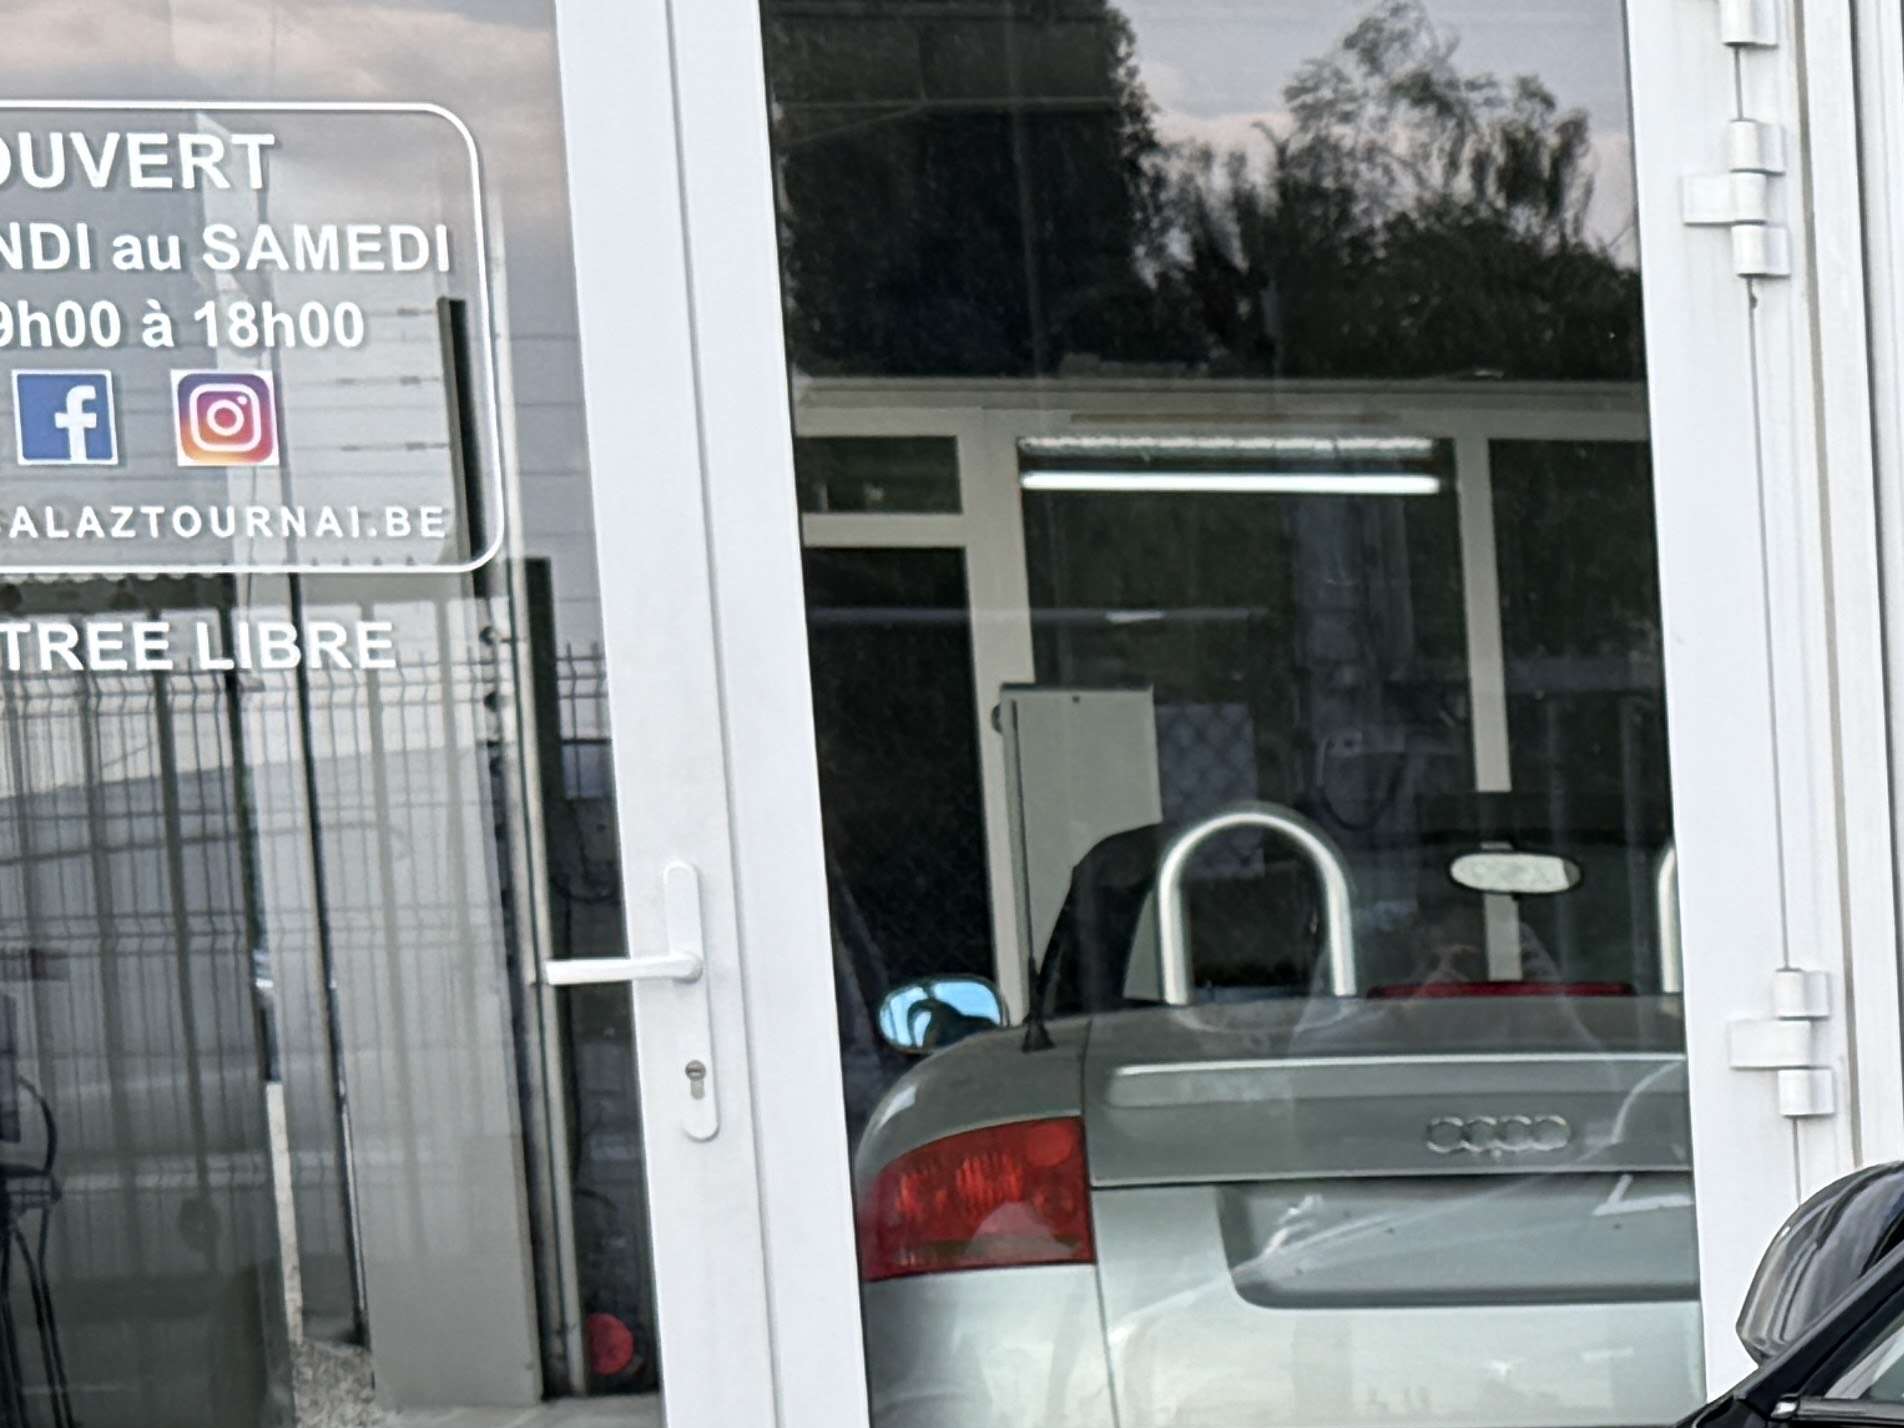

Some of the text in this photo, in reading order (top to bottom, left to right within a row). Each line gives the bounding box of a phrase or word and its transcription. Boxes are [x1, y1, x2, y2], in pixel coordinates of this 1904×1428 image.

[0, 131, 275, 189] UVERT
[112, 233, 181, 271] au
[202, 223, 451, 272] SAMEDI
[142, 298, 174, 348] à
[194, 299, 364, 348] 18h00
[0, 505, 446, 538] ALAZTOURNAI.BE
[201, 621, 397, 672] LIBRE
